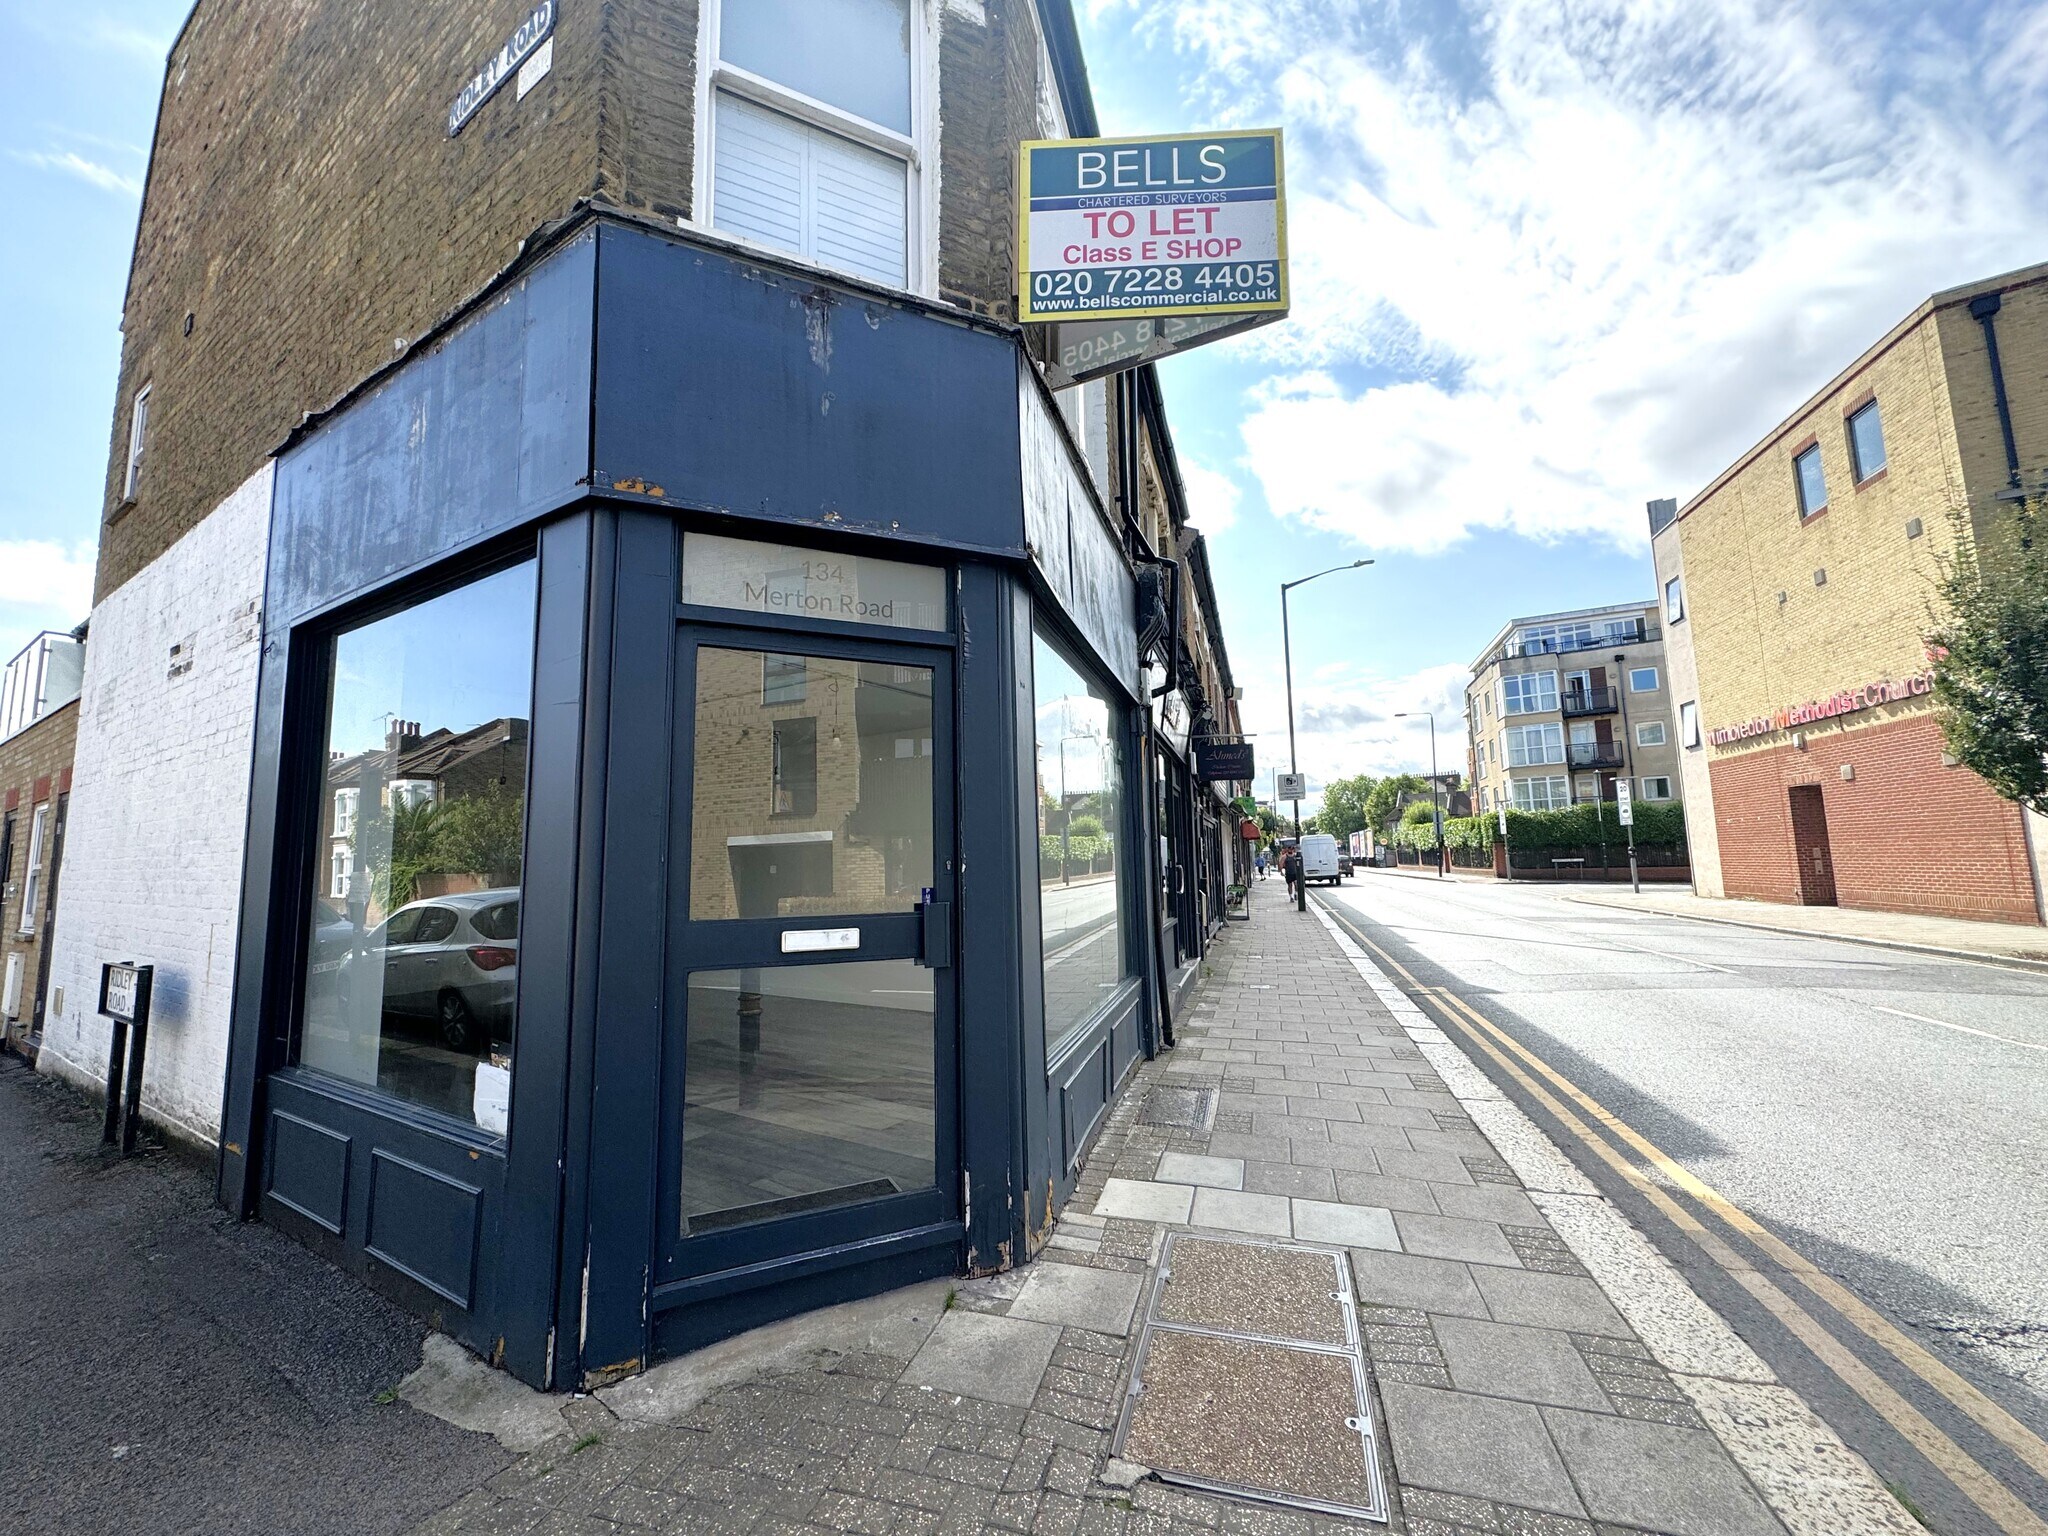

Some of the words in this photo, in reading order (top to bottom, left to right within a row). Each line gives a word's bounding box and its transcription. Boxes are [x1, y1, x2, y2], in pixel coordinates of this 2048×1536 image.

[449, 56, 500, 126] RIDLEY
[506, 3, 549, 66] ROAD
[1077, 144, 1227, 190] BELLS
[1077, 194, 1150, 209] CHARTERED
[1155, 191, 1228, 205] SURVEYORS
[1083, 210, 1136, 239] TO
[1149, 207, 1221, 236] LET
[1062, 244, 1132, 264] Class
[1141, 241, 1158, 260] E
[1166, 237, 1242, 260] SHOP
[1034, 271, 1093, 297] 020
[1104, 267, 1183, 293] 7228
[1194, 263, 1275, 289] 4405
[1032, 287, 1278, 311] www.bellscommercial.co.uk
[801, 560, 845, 584] 134
[744, 581, 833, 610] Merton
[839, 594, 894, 619] Road
[1774, 690, 1860, 730] Methodist
[1863, 670, 1937, 706] Church
[110, 968, 134, 991] RIDLEY
[108, 991, 126, 1012] ROAD
